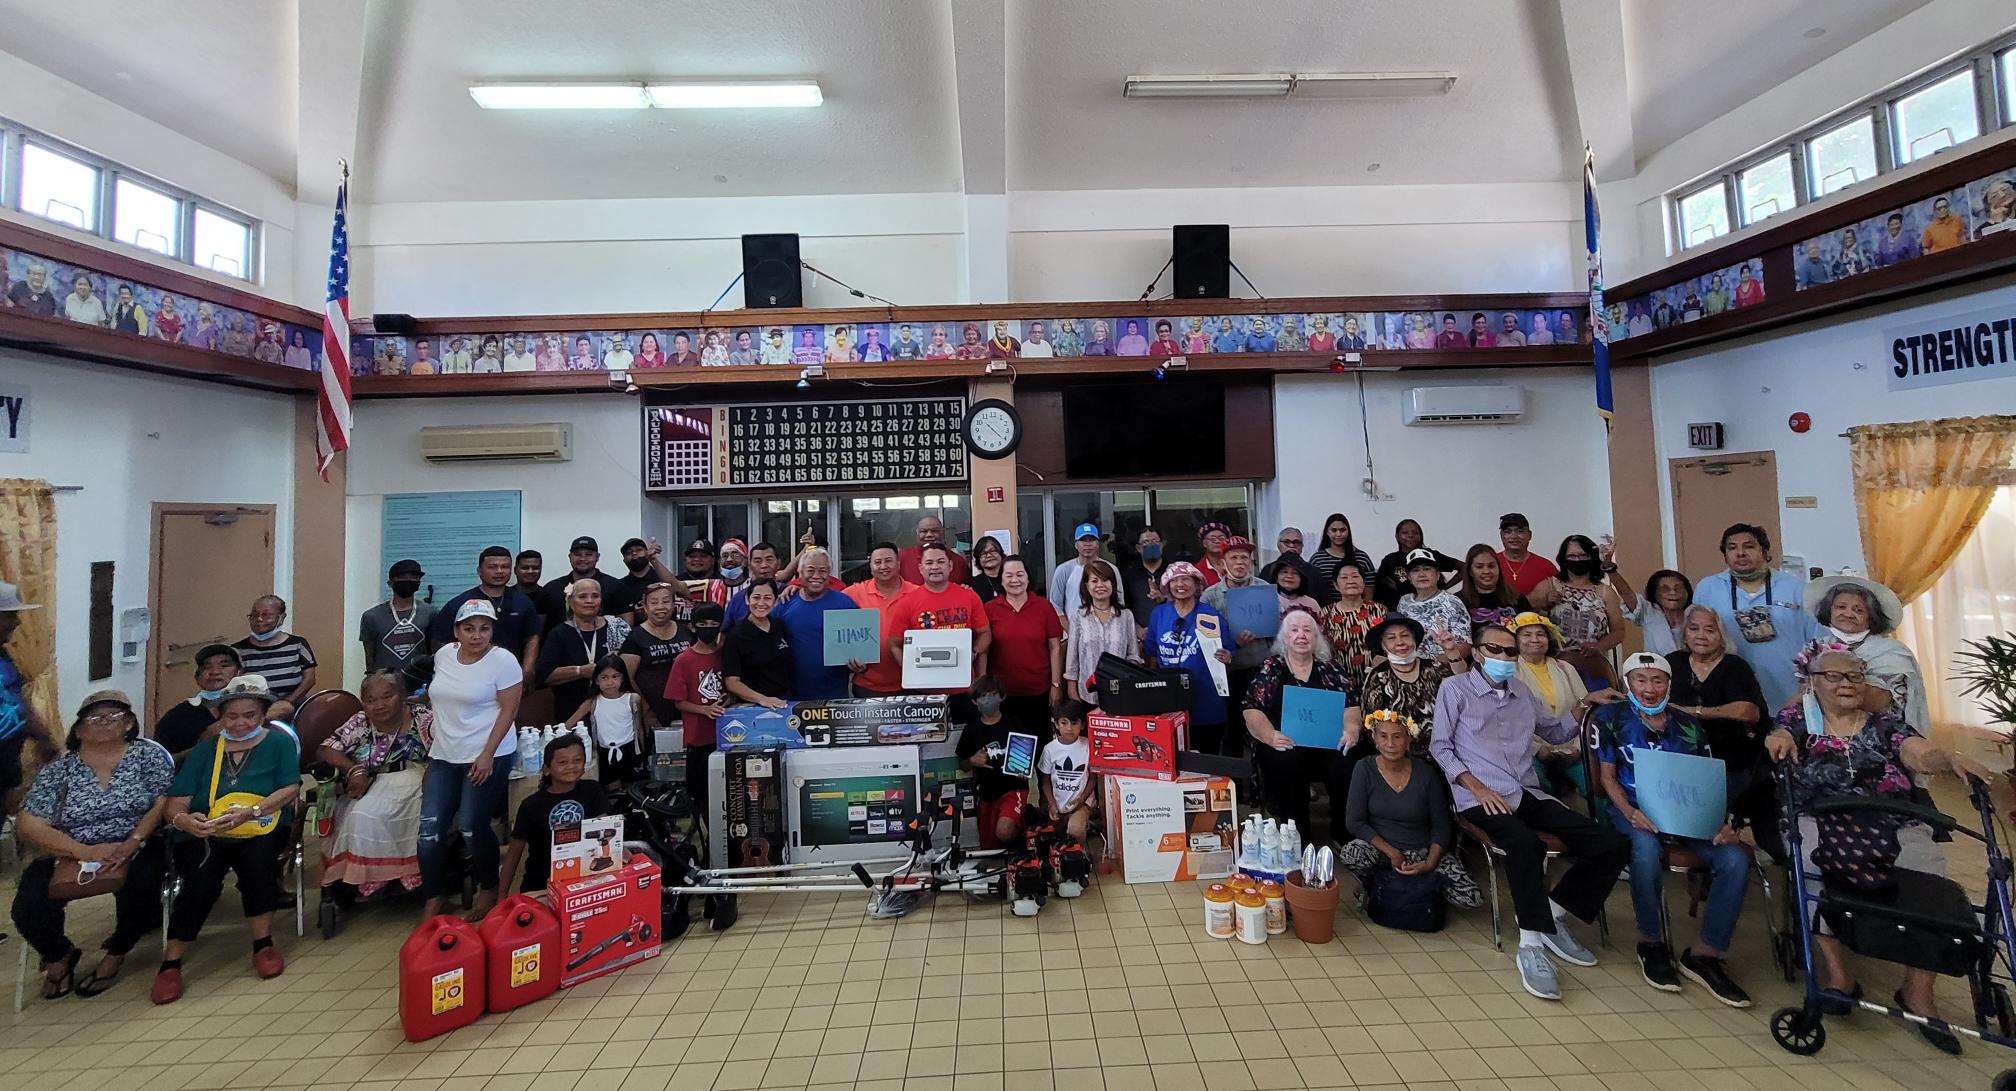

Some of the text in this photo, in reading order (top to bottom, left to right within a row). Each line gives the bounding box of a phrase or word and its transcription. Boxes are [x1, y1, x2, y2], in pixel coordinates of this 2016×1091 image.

[1893, 317, 2016, 378] STRENGT
[736, 403, 959, 421] 1 2 3 4 5 6 7 8 9 10 11 12 13 14 15
[734, 418, 960, 436] 16 17 18 19 20 21 22 23 24 25 26 27 28 29 30
[1691, 426, 1712, 446] EXIT
[734, 433, 961, 452] 31 32 33 34 35 36 37 38 39 40 41 42 43 44 45
[733, 448, 961, 467] 46 47 48 49 50 51 52 53 54 55 56 57 58 59 60
[734, 464, 962, 483] 61 62 63 64 65 66 67 68 69 70 71 72 73 74 75
[650, 649, 669, 657] WITH
[802, 706, 945, 721] ONE Touch Instant Canopy
[1092, 719, 1128, 728] CRAFTSMAN
[1163, 837, 1168, 845] 6
[569, 886, 623, 908] CRAFTSMAN
